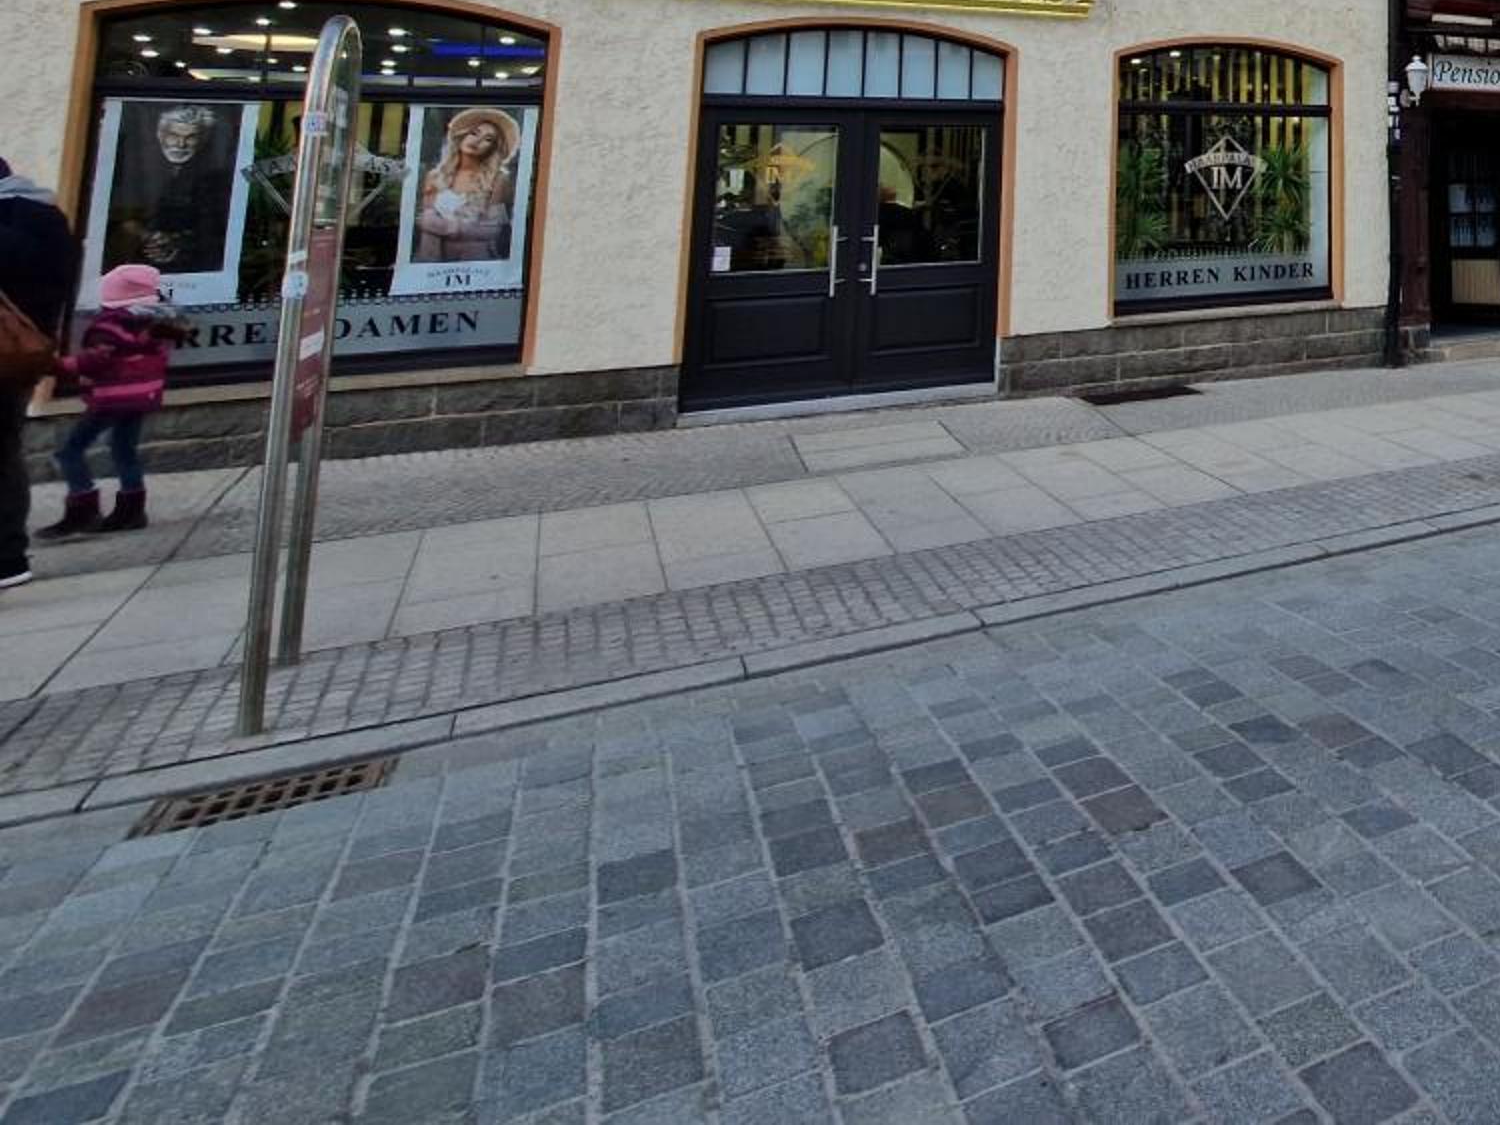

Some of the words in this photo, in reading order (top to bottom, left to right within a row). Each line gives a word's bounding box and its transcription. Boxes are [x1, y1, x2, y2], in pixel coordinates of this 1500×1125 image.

[1211, 166, 1243, 190] IM
[1126, 266, 1220, 290] HERREN
[1234, 261, 1314, 283] KINDER
[335, 311, 479, 341] DAMEN
